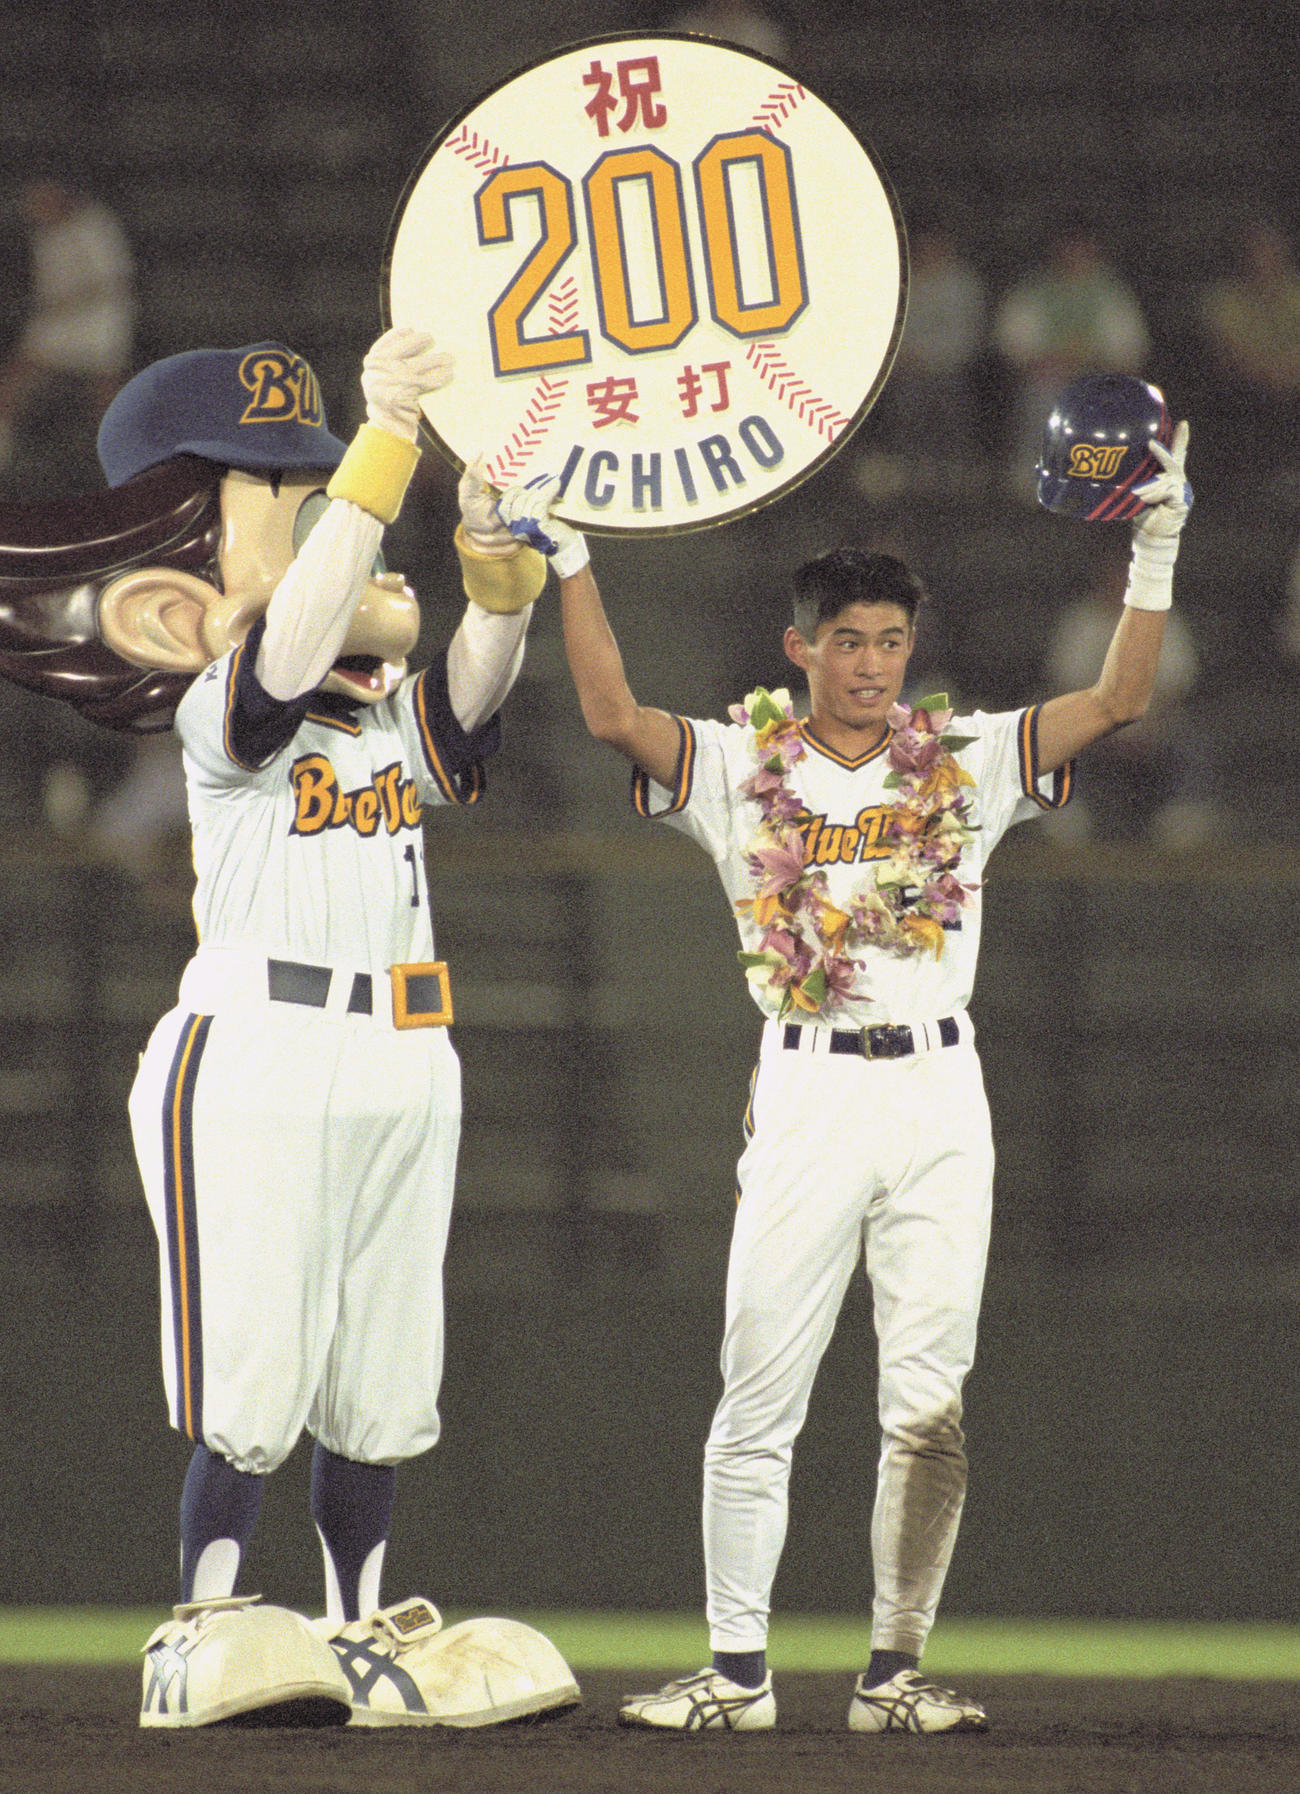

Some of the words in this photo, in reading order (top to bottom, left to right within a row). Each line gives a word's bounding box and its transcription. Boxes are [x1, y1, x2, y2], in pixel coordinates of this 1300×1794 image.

[582, 56, 667, 137] 祝
[474, 127, 810, 378] 200
[556, 414, 785, 512] ICHIRO
[1067, 444, 1128, 479] BW
